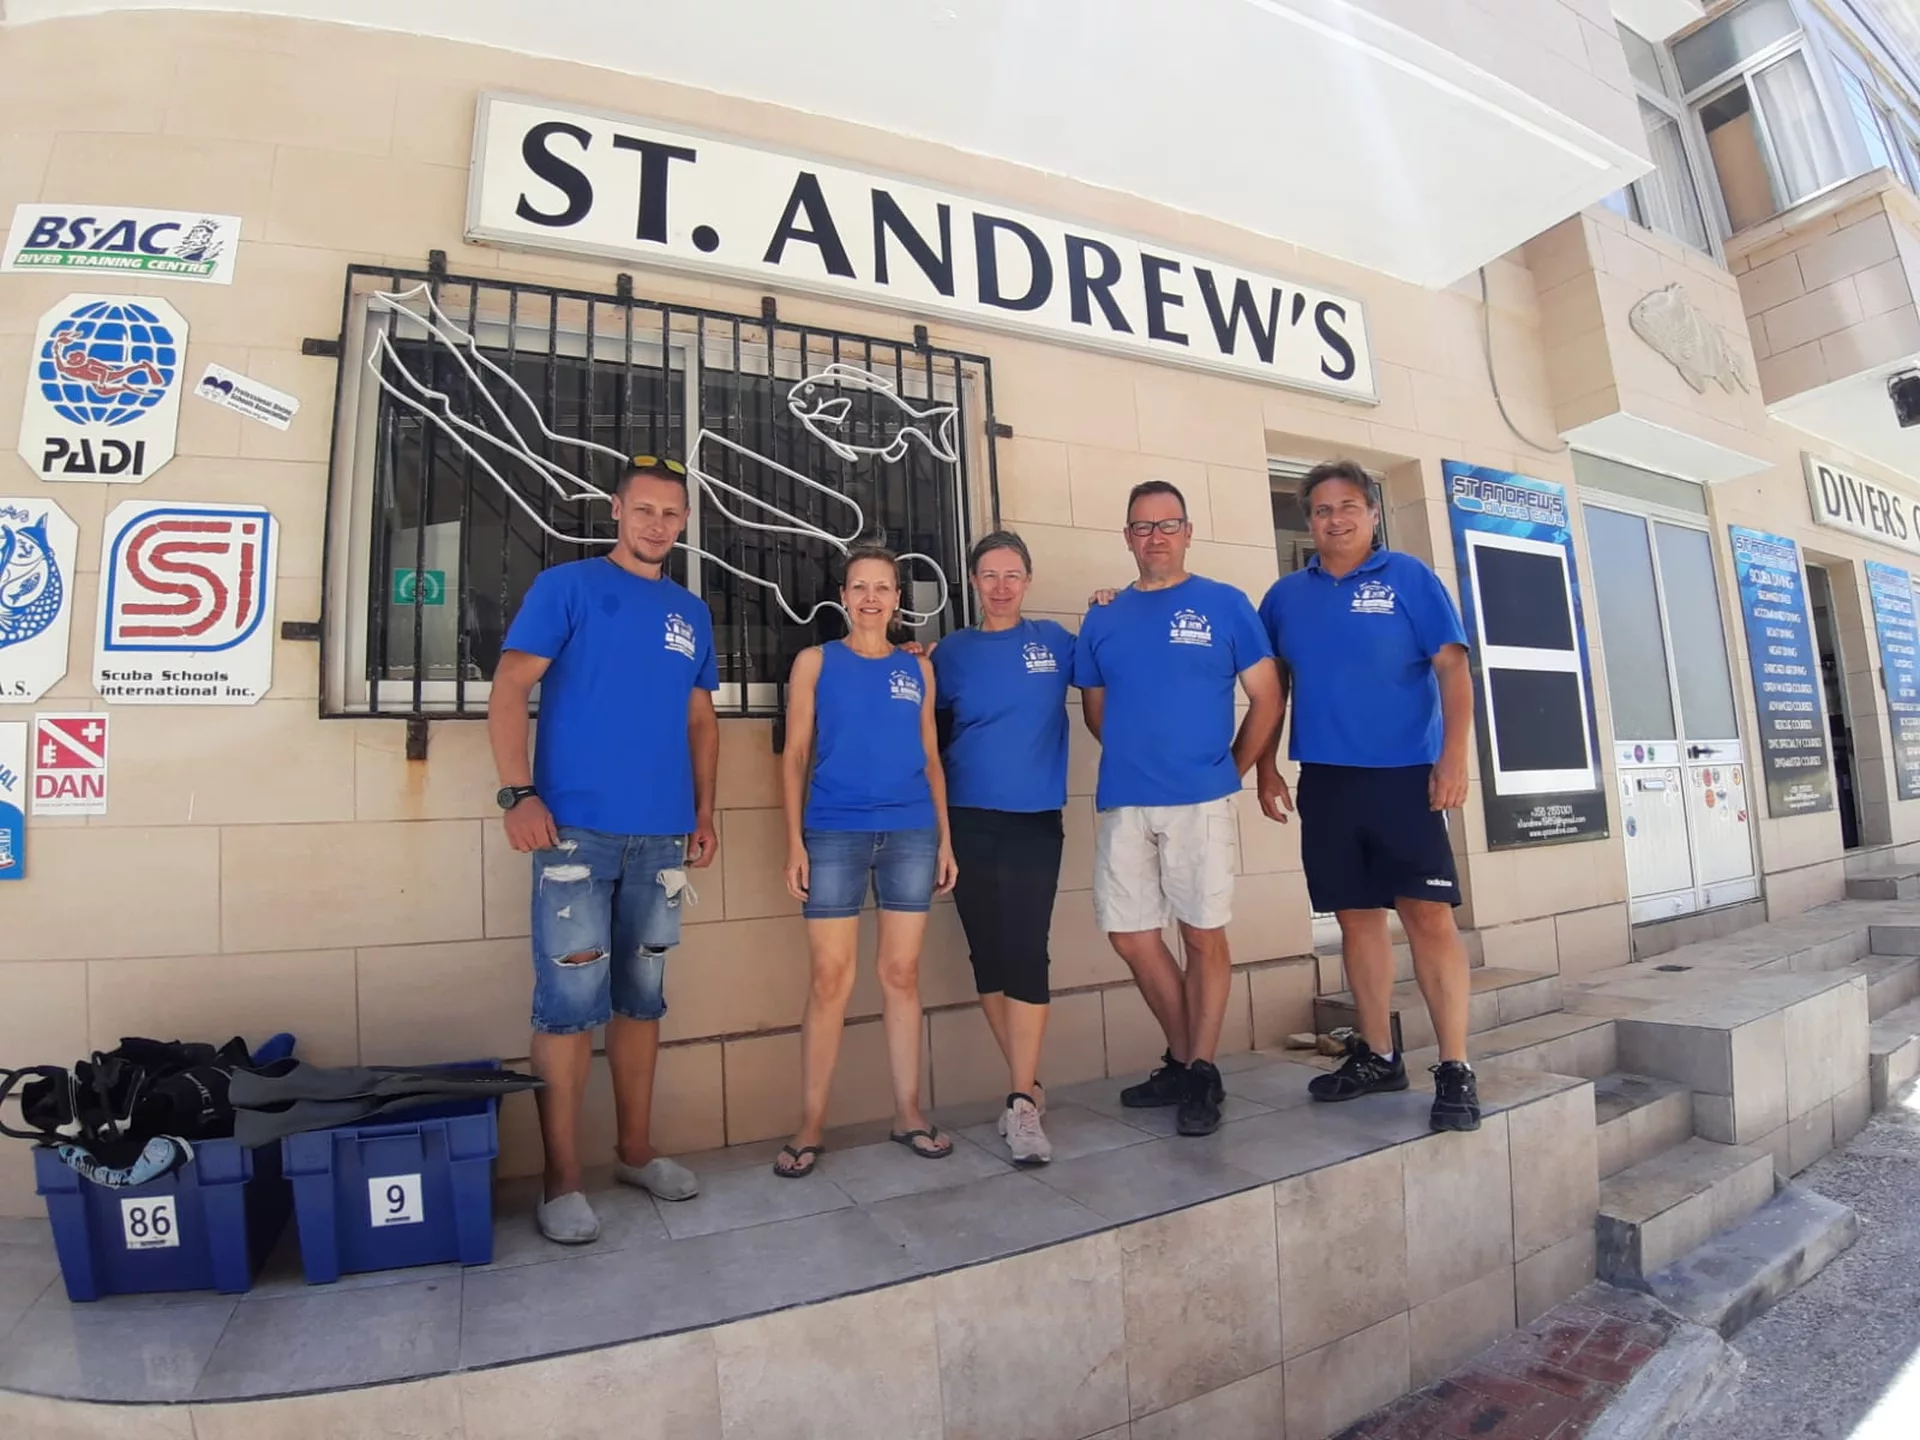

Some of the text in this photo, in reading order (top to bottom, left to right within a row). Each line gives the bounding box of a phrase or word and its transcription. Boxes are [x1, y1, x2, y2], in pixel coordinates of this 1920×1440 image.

[17, 253, 210, 273] DIVER TRAINING CENTRE
[514, 119, 1357, 381] ST. ANDREW'S
[42, 437, 146, 476] PADI
[1818, 466, 1907, 540] DIVERS
[101, 670, 229, 681] Scuba Schools
[226, 685, 256, 696] inc.
[35, 774, 104, 798] DAN
[387, 1184, 405, 1213] 9
[130, 1205, 171, 1237] 86
